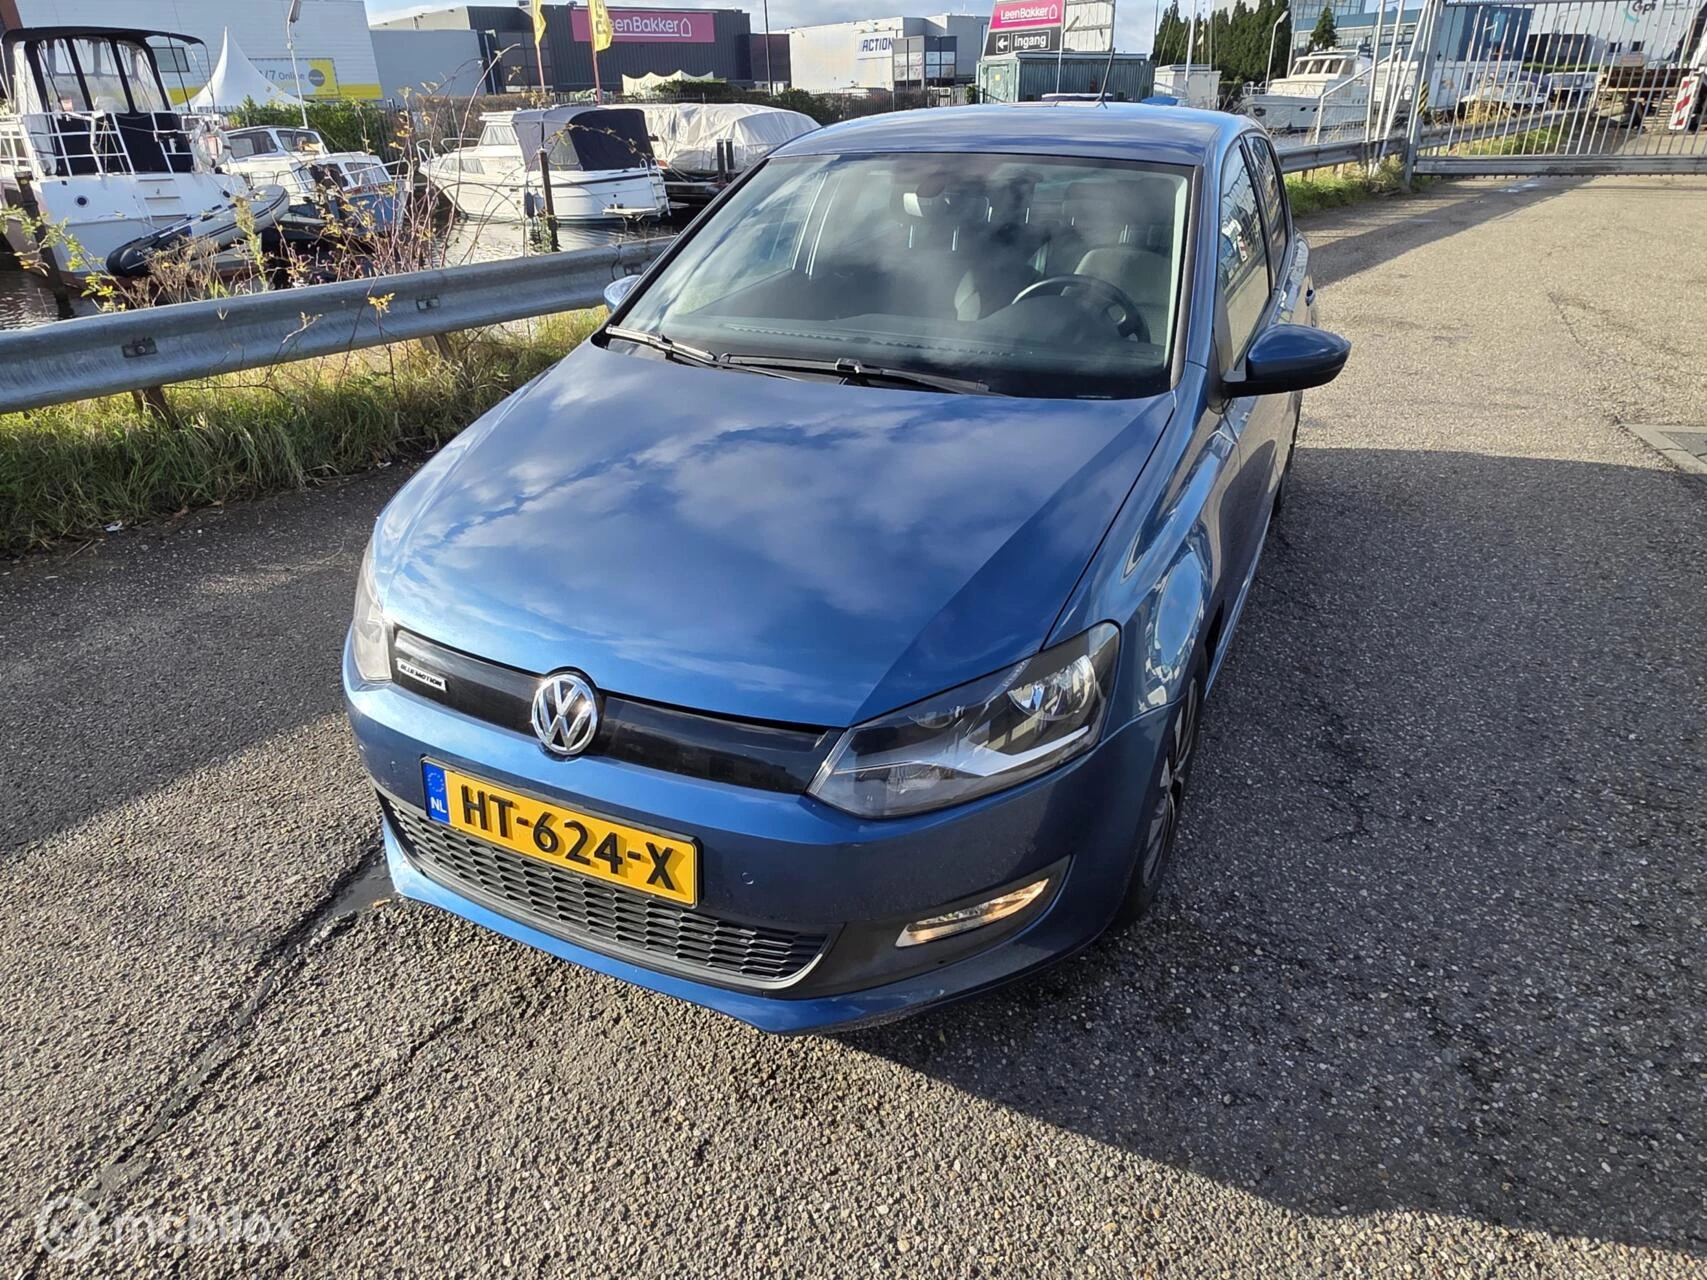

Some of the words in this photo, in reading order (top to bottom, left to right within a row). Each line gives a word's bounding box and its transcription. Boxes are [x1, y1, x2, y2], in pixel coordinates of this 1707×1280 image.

[1000, 7, 1049, 20] LeenBakker
[609, 16, 679, 33] eenBakker
[862, 37, 893, 52] ACTION
[1014, 35, 1047, 48] ingang
[430, 796, 447, 813] NL
[460, 784, 675, 890] HT-624-X
